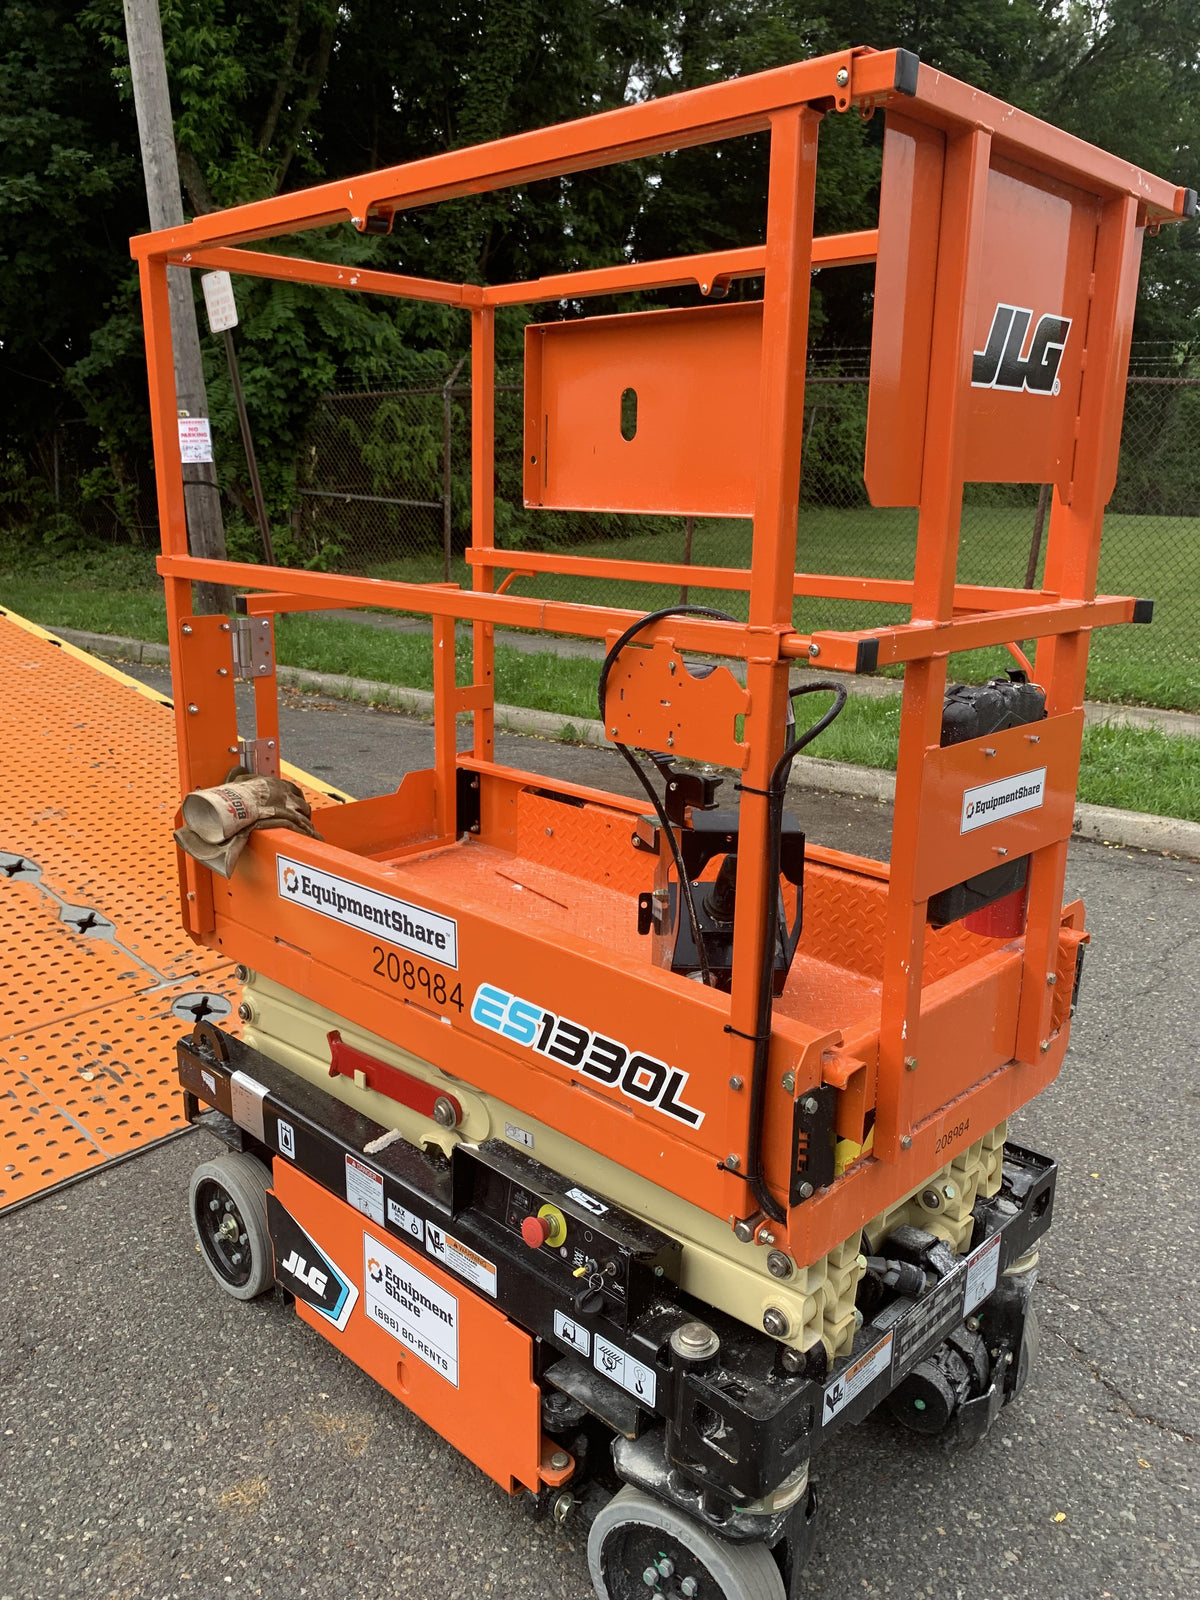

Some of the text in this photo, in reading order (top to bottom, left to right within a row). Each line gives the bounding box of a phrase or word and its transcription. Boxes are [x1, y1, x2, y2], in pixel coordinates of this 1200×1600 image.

[970, 303, 1072, 395] JLG
[975, 783, 1041, 814] EquipmentShare
[301, 875, 446, 950] EquipmentShare
[373, 946, 465, 1013] 208984
[471, 983, 705, 1129] ES1330L
[935, 1117, 970, 1154] 208984
[282, 1250, 329, 1297] JLG
[384, 1265, 454, 1327] Equipment
[384, 1282, 421, 1318] Share
[374, 1305, 448, 1371] (888) 80-RENTS
